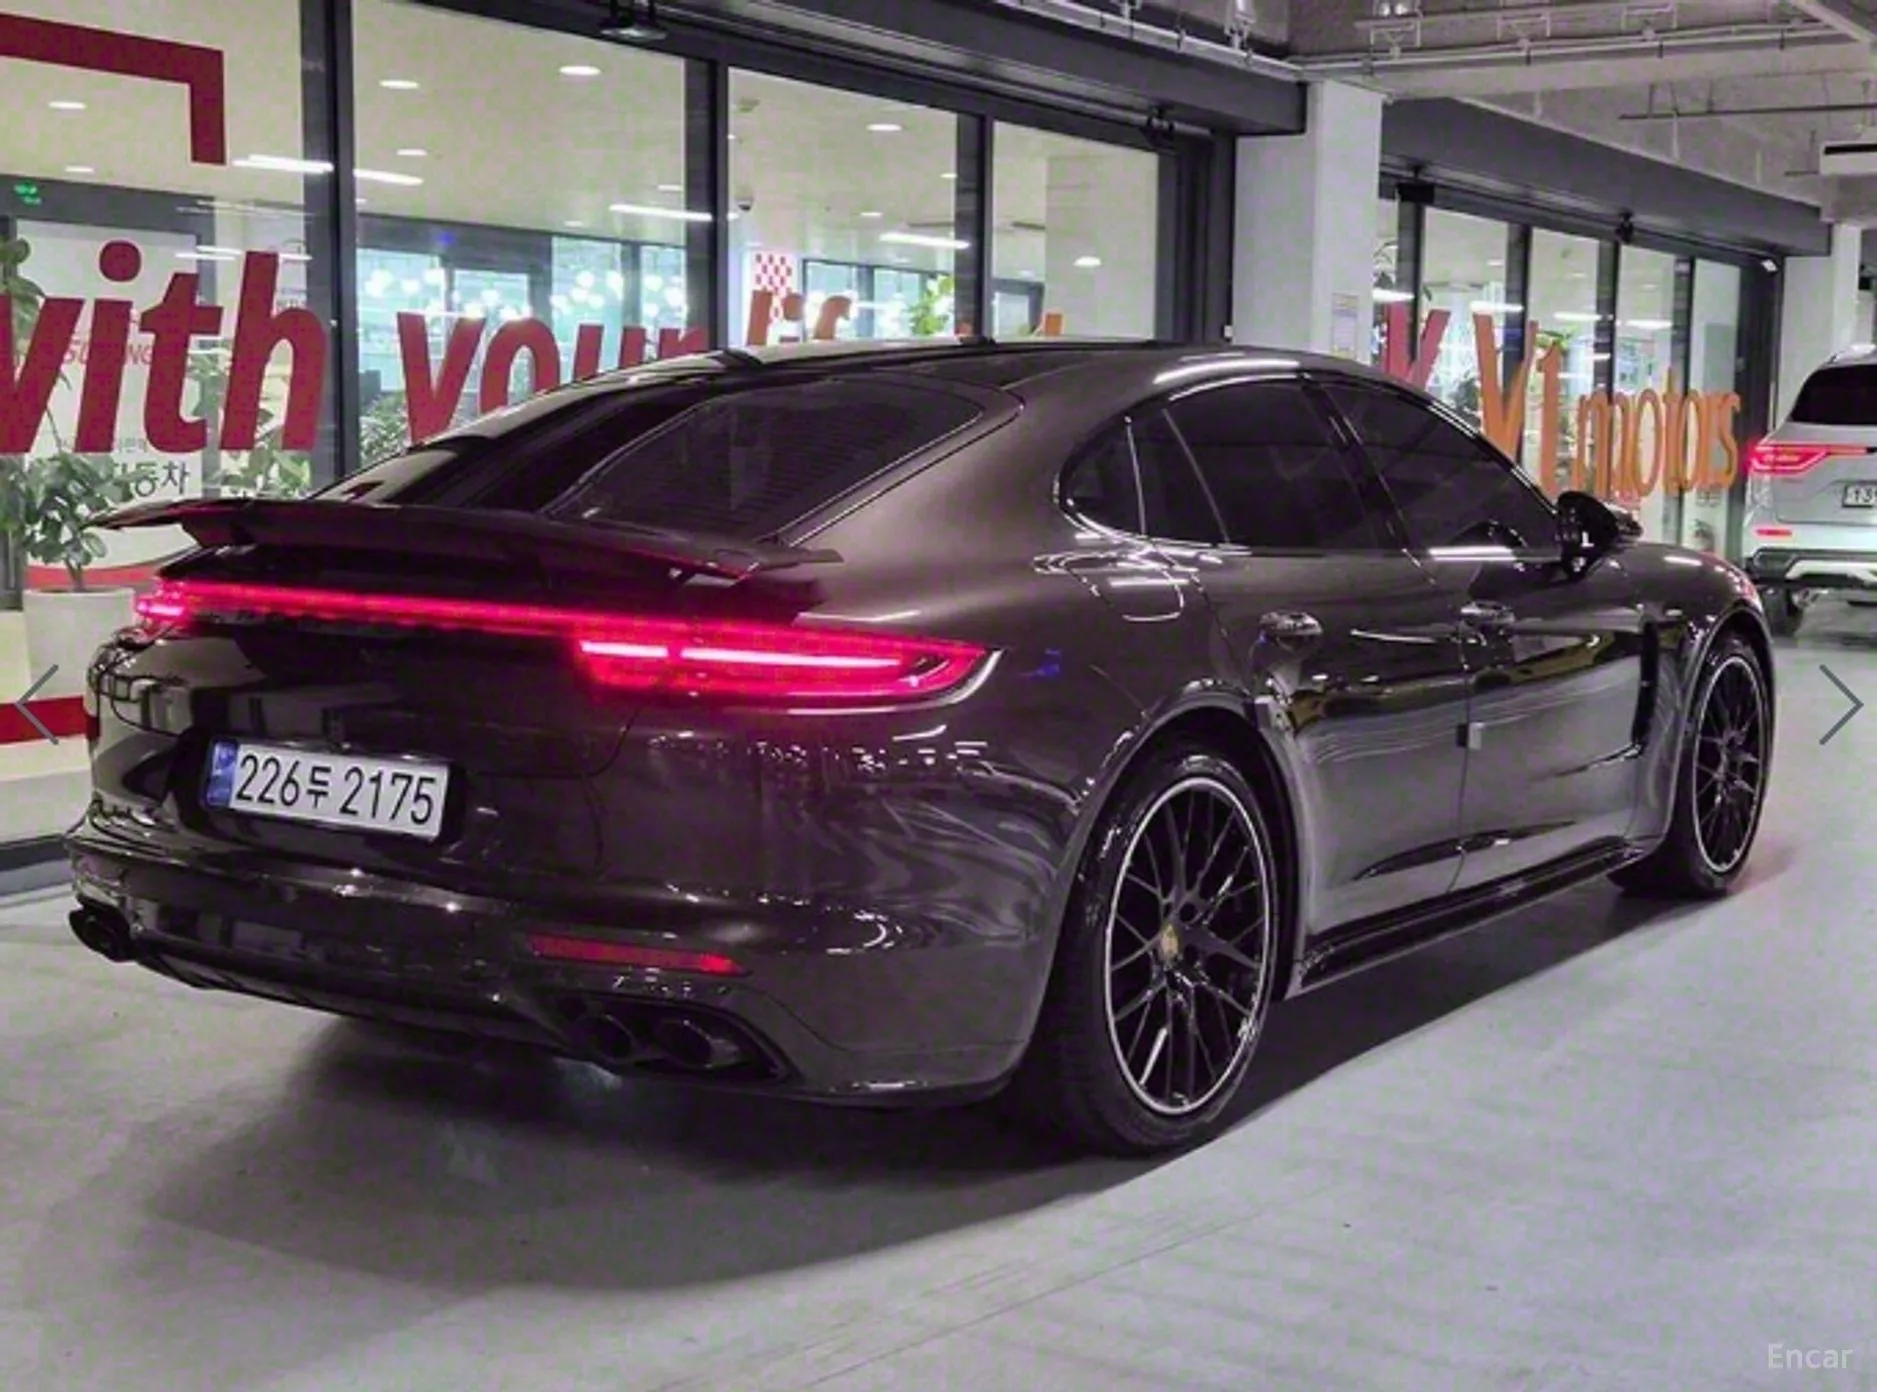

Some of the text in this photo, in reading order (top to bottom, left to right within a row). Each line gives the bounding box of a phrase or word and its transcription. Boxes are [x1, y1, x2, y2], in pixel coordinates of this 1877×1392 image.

[397, 312, 709, 446] yo
[236, 755, 436, 825] 226두 2175
